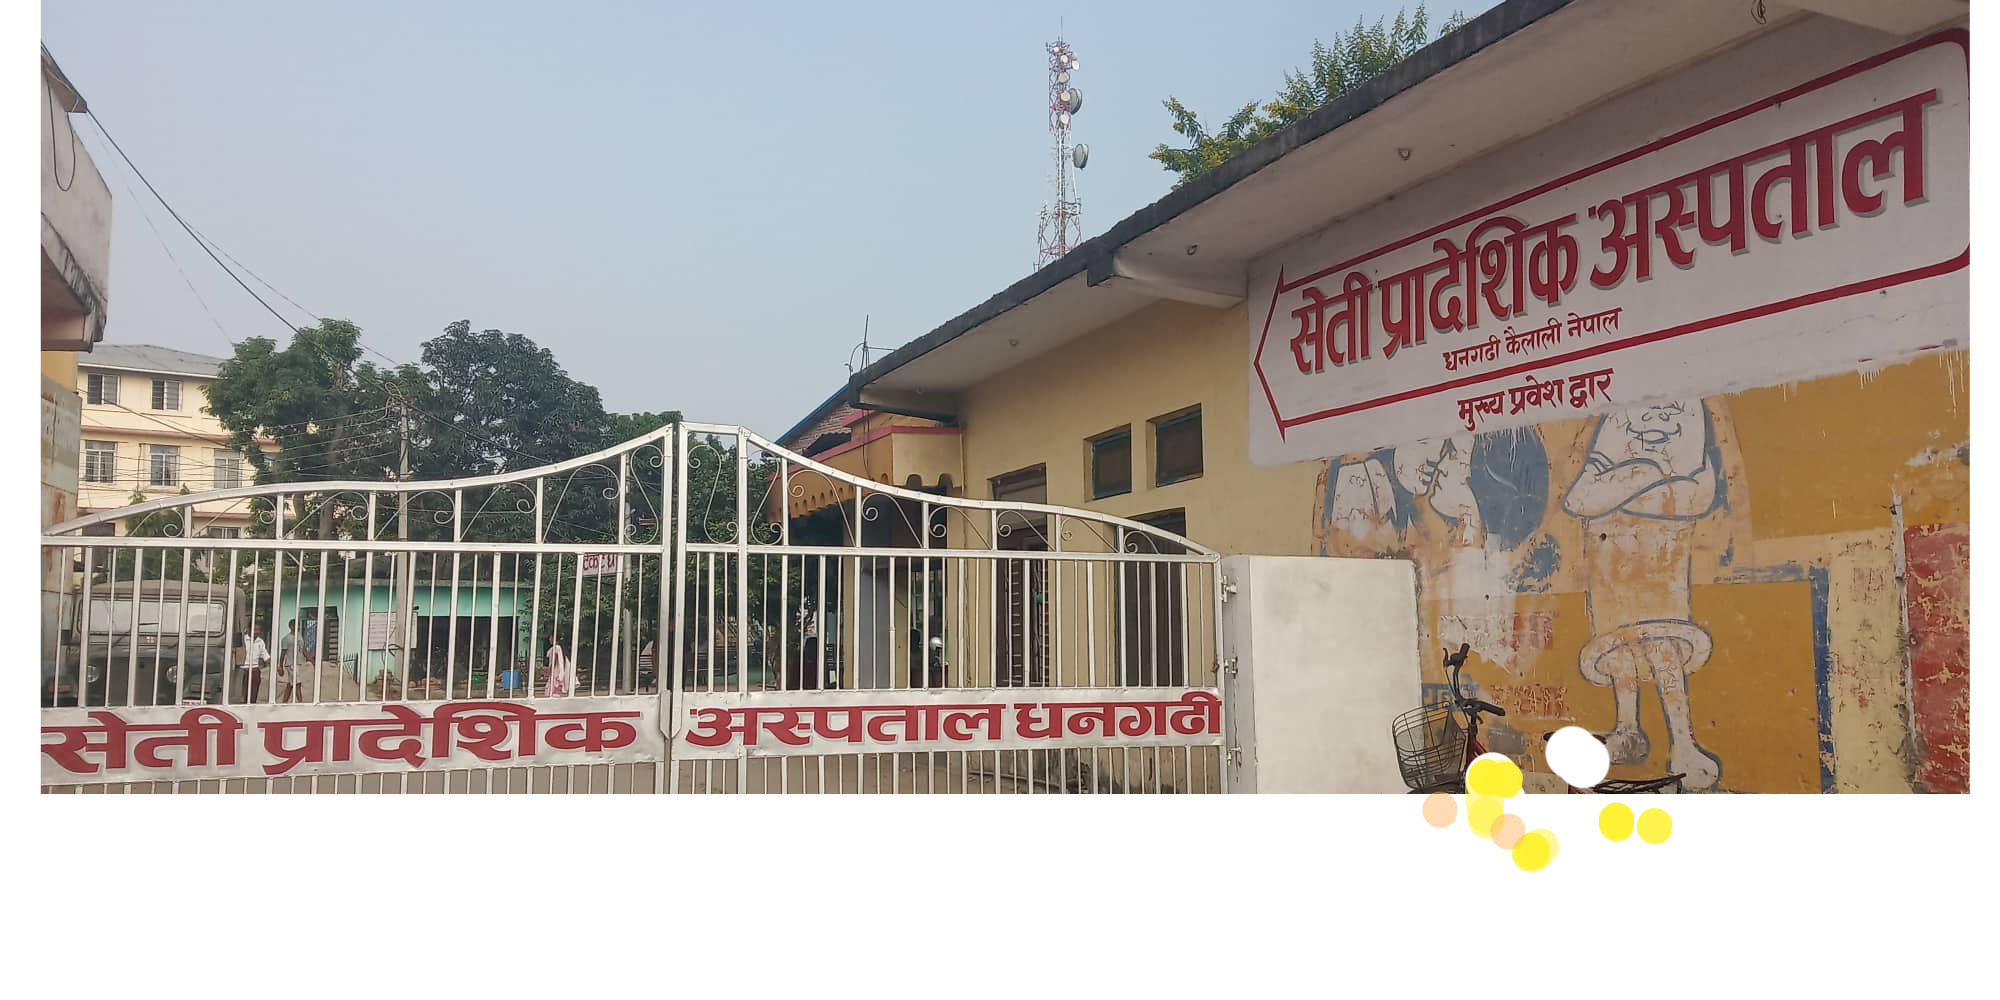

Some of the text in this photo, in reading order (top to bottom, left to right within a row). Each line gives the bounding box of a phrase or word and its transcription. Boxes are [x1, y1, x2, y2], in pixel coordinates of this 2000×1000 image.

[1290, 88, 1938, 374] सेती प्रादेशिक अस्पताल
[1504, 316, 1562, 355] कैलाली
[1567, 307, 1622, 337] नेपाल
[1457, 368, 1614, 430] मुख्य प्रवेश द्वार
[40, 690, 1223, 775] सेती प्रादेशिक अस्पताल धनगढी
